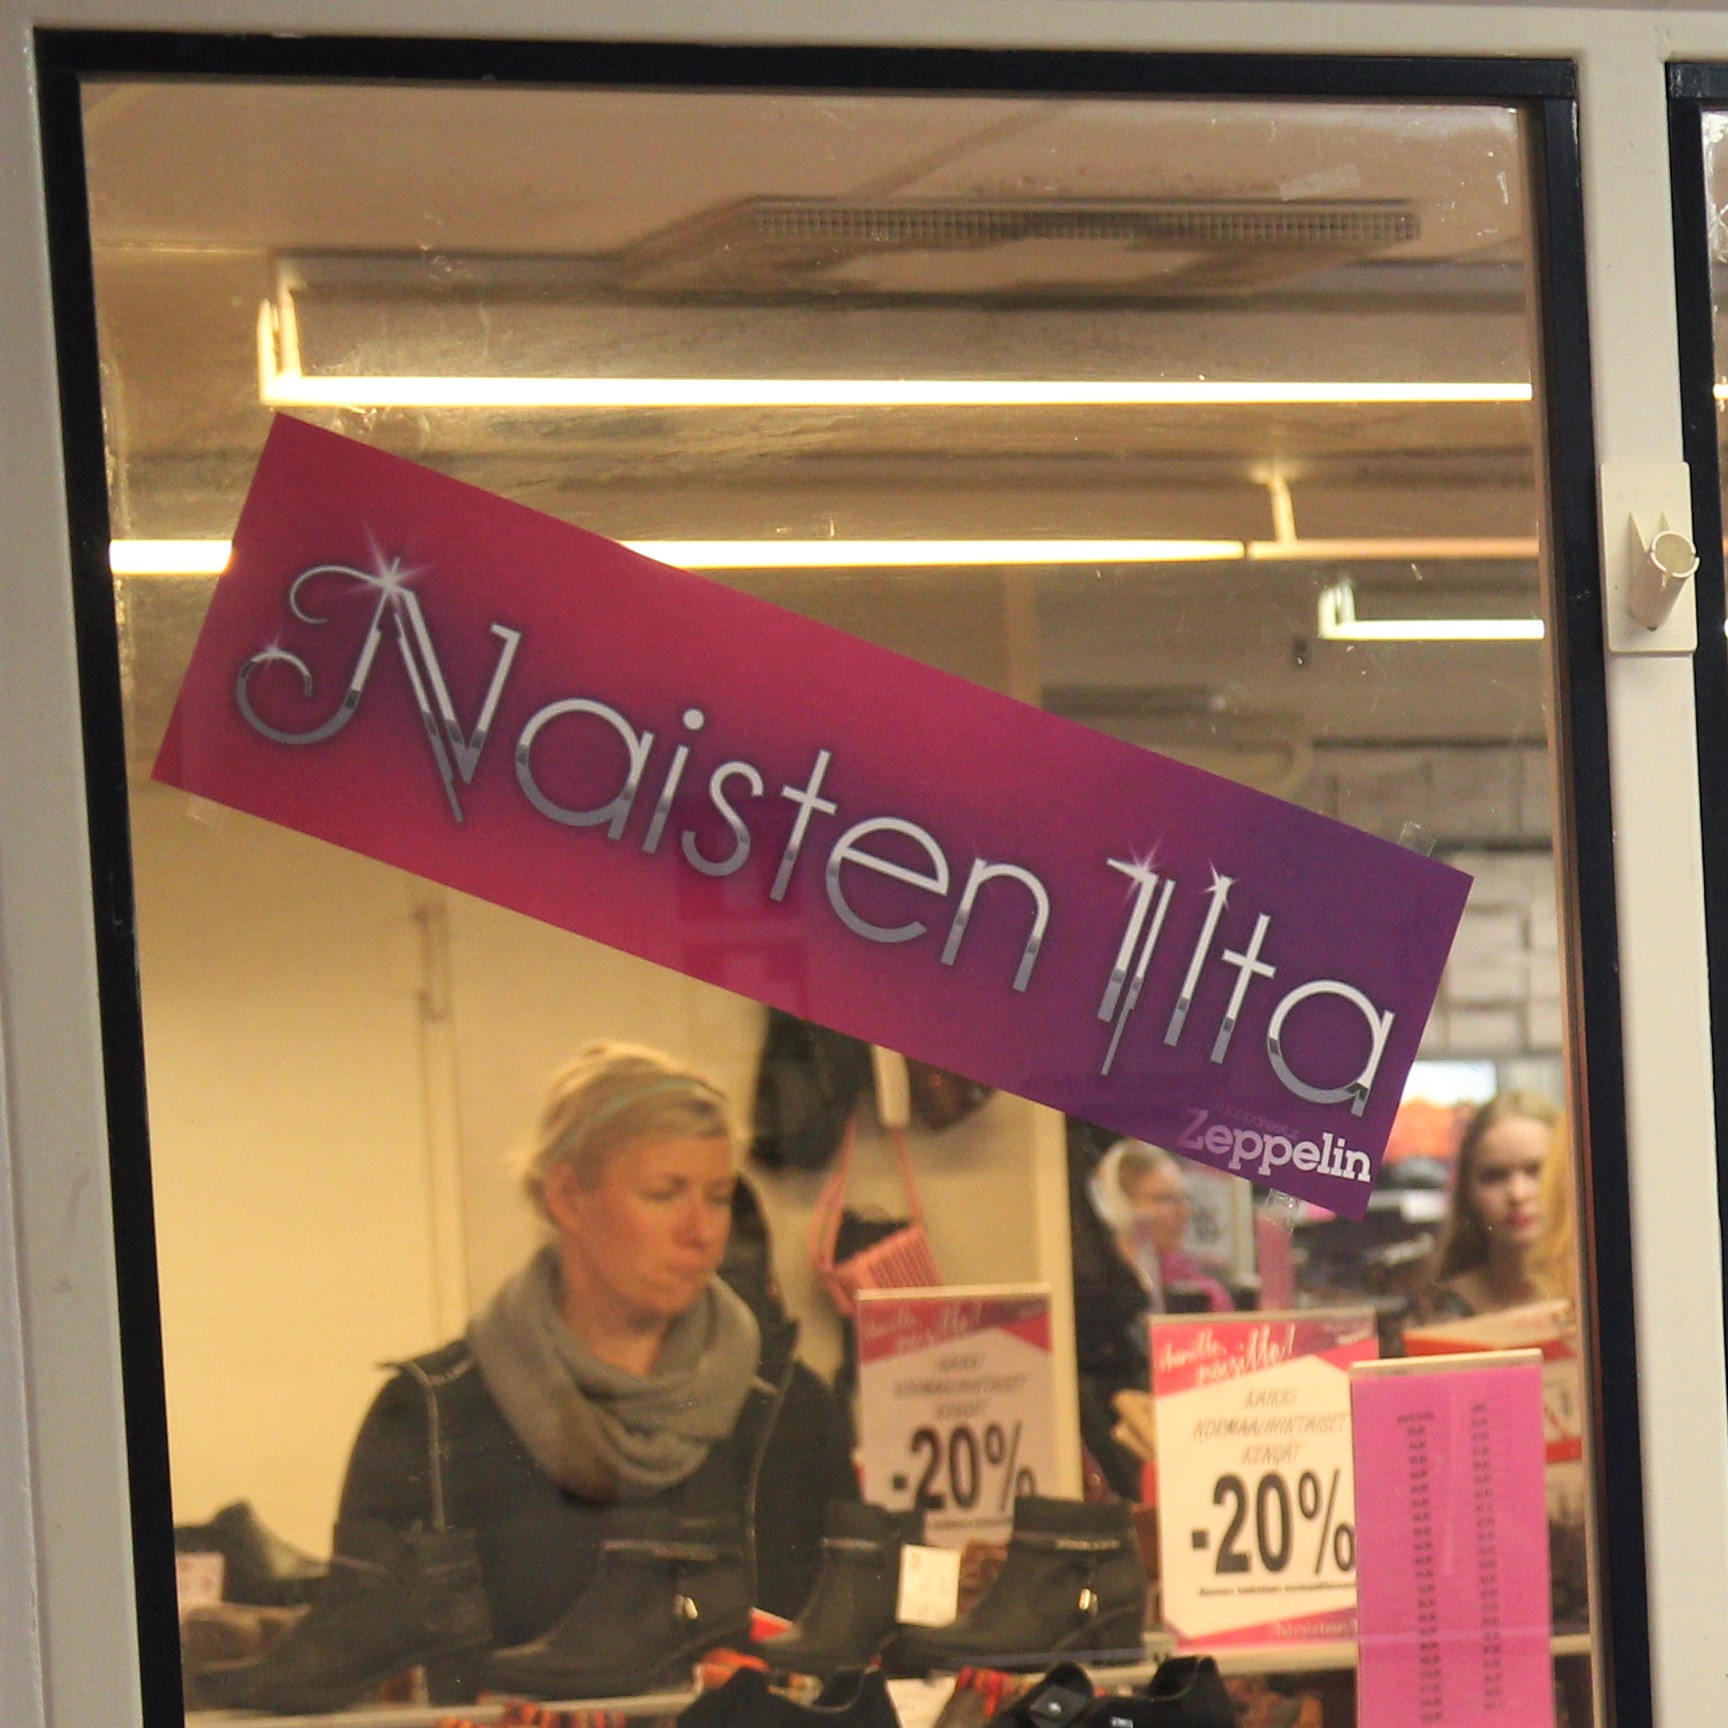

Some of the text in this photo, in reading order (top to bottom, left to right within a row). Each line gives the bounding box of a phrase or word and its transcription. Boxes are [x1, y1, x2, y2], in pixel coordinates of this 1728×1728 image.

[234, 555, 1394, 1118] Naisten Ilta
[1178, 1107, 1373, 1184] Zeppelin
[891, 1419, 1039, 1510] -20%
[1191, 1468, 1356, 1576] -20%
